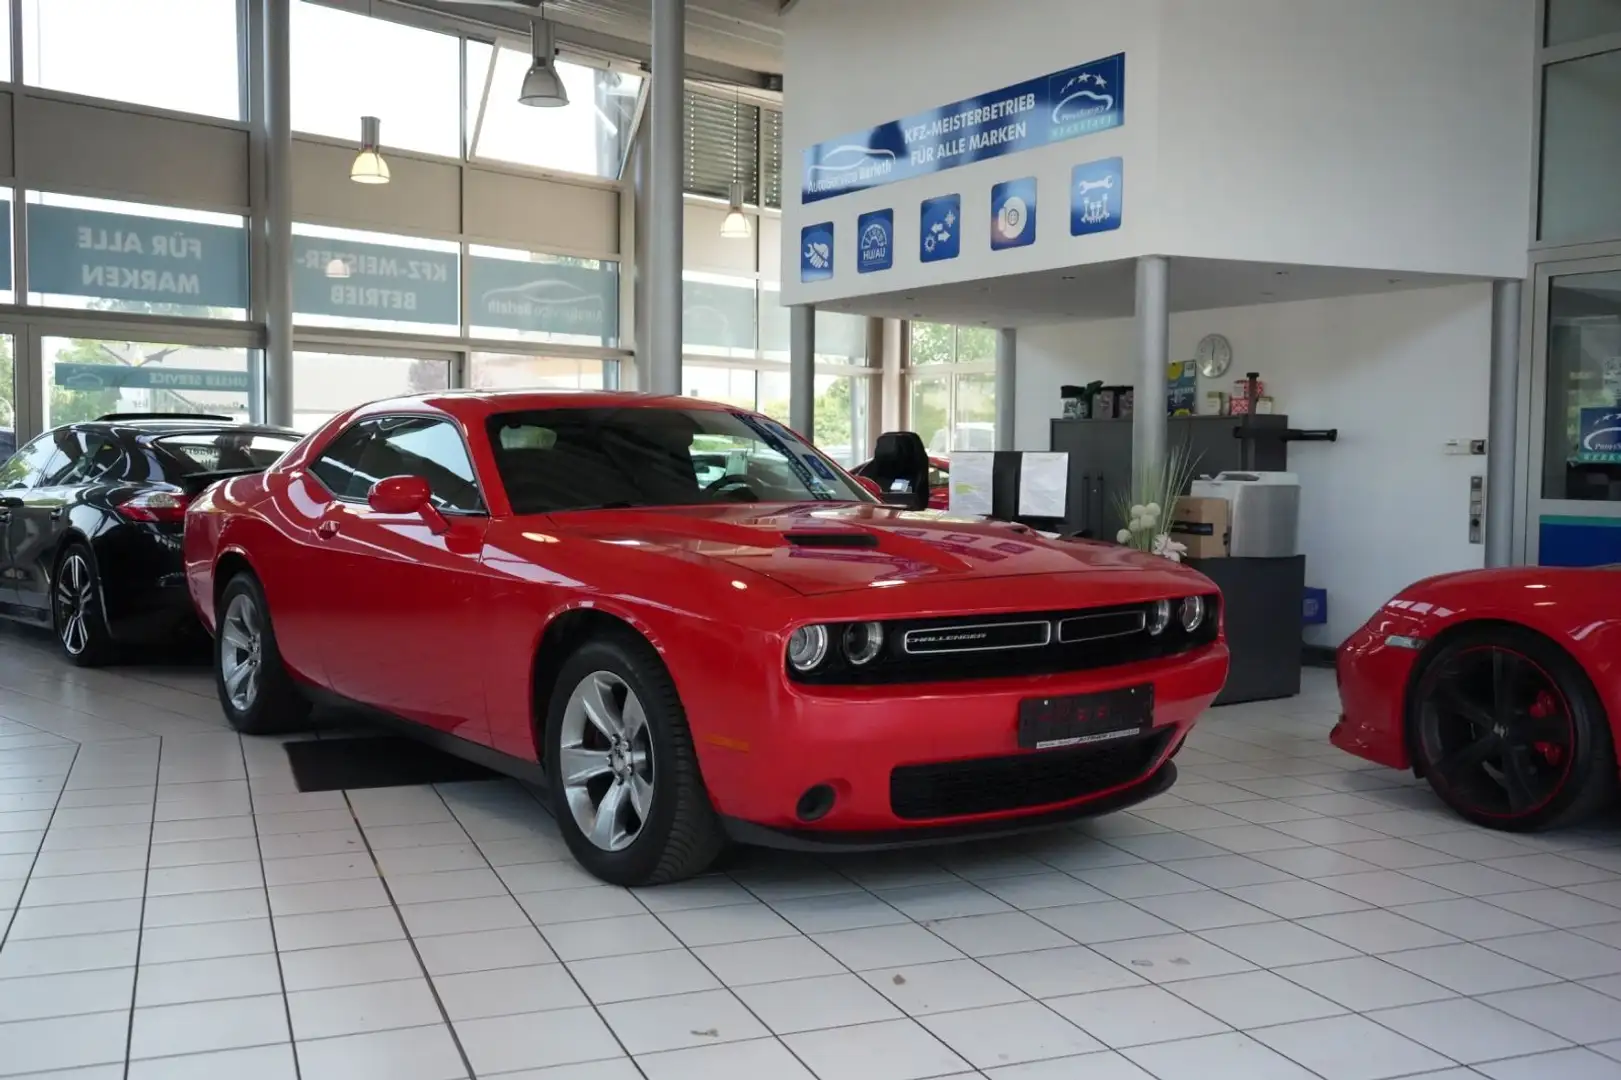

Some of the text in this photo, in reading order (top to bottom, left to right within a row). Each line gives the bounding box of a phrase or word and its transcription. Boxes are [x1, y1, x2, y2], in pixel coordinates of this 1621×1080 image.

[904, 93, 1035, 144] KFZ-MEISTERBETRIEB
[911, 121, 1027, 167] FÜR ALLE MARKEN
[863, 247, 886, 260] HU/AU
[906, 633, 987, 643] CHALLENGER
